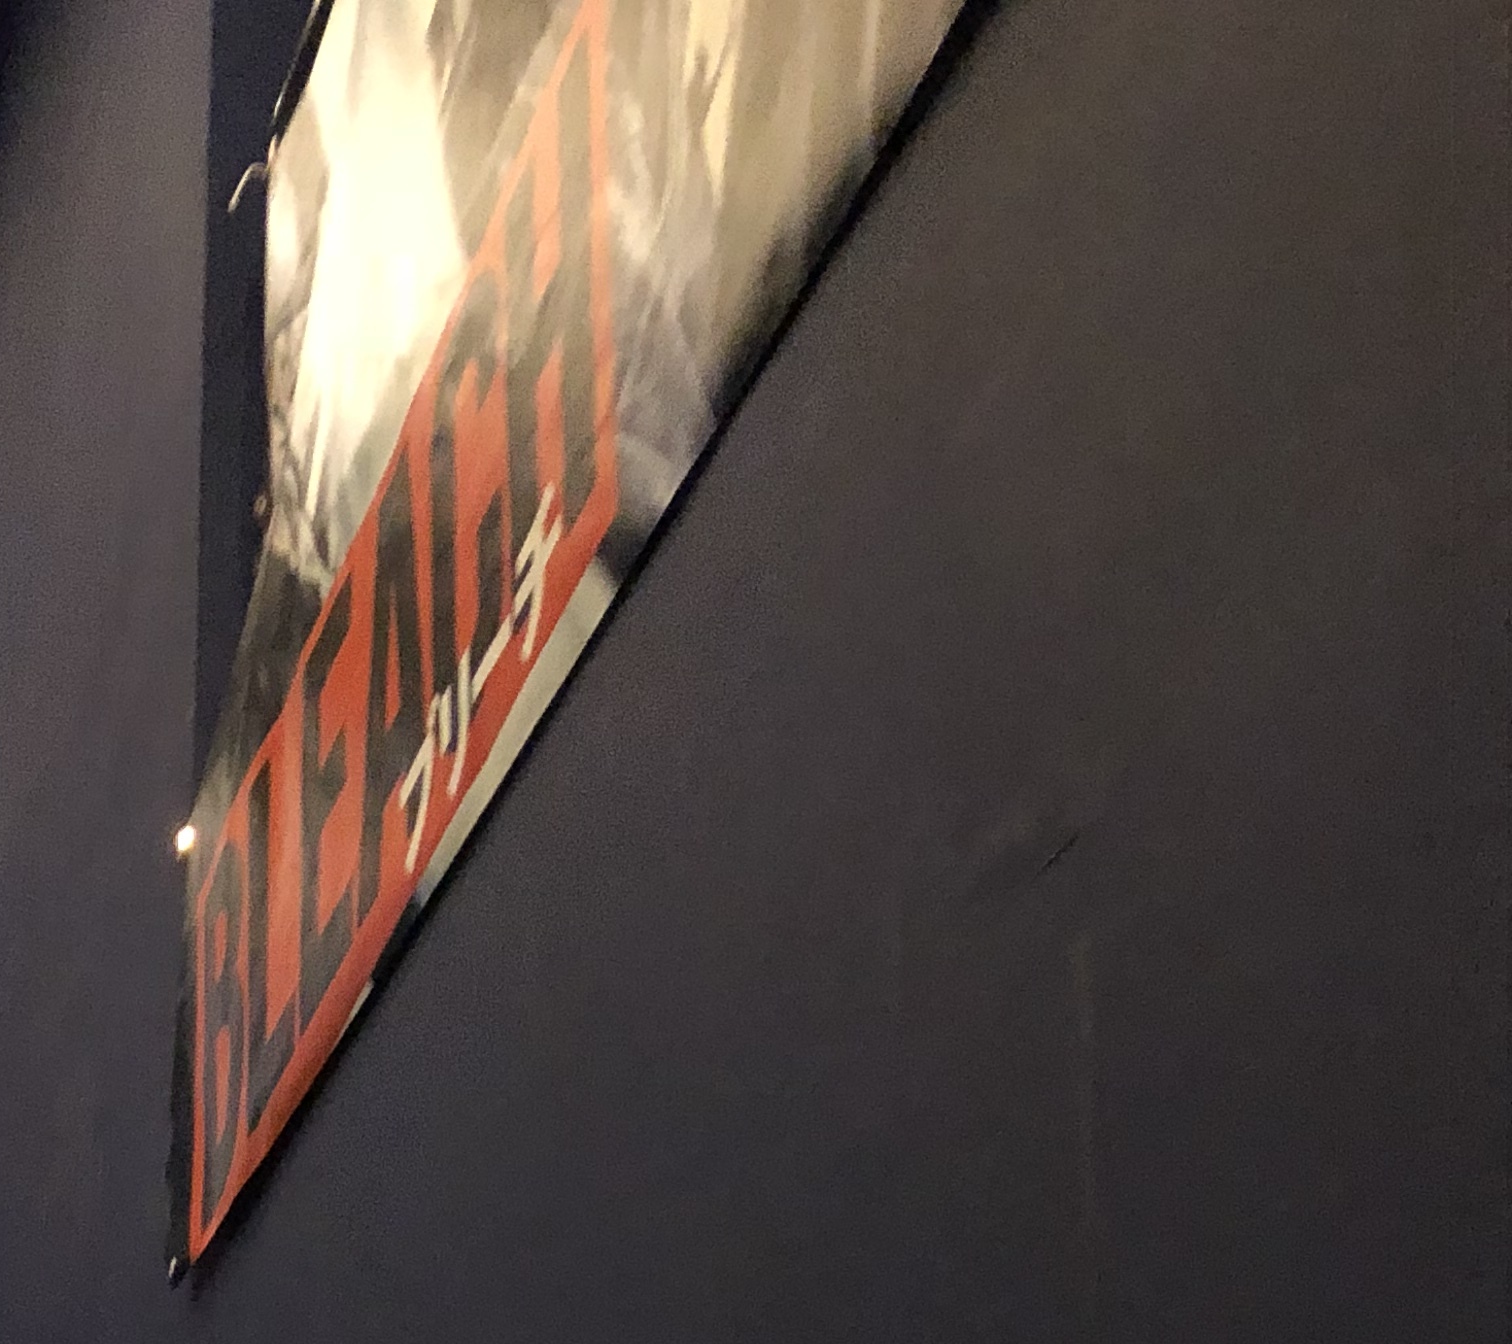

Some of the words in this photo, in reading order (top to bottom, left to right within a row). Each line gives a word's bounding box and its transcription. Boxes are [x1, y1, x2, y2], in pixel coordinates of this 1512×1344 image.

[199, 18, 592, 1236] BLEACH
[399, 482, 562, 874] ブリーチ
